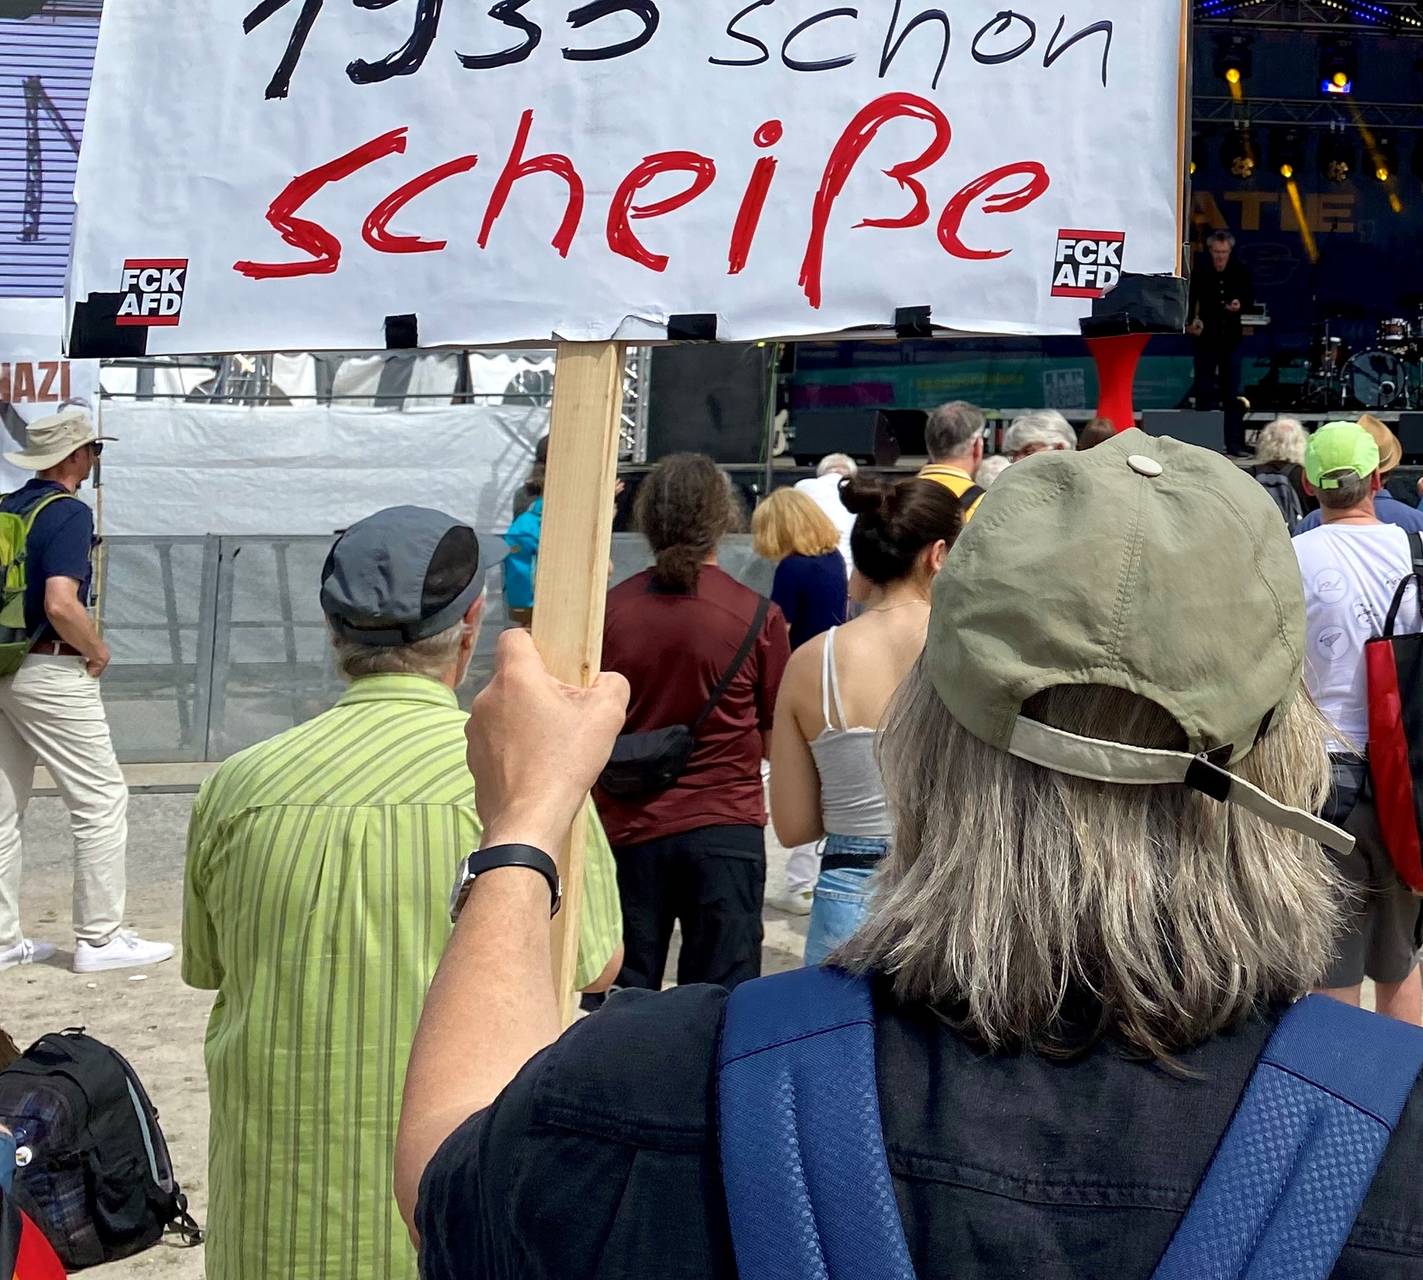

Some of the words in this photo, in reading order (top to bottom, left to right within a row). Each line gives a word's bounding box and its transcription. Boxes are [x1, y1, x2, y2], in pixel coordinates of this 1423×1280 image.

[708, 0, 1113, 89] schon
[1056, 238, 1122, 265] FCK
[121, 268, 185, 292] FCK
[1053, 263, 1120, 288] AFD
[117, 293, 181, 316] AFD
